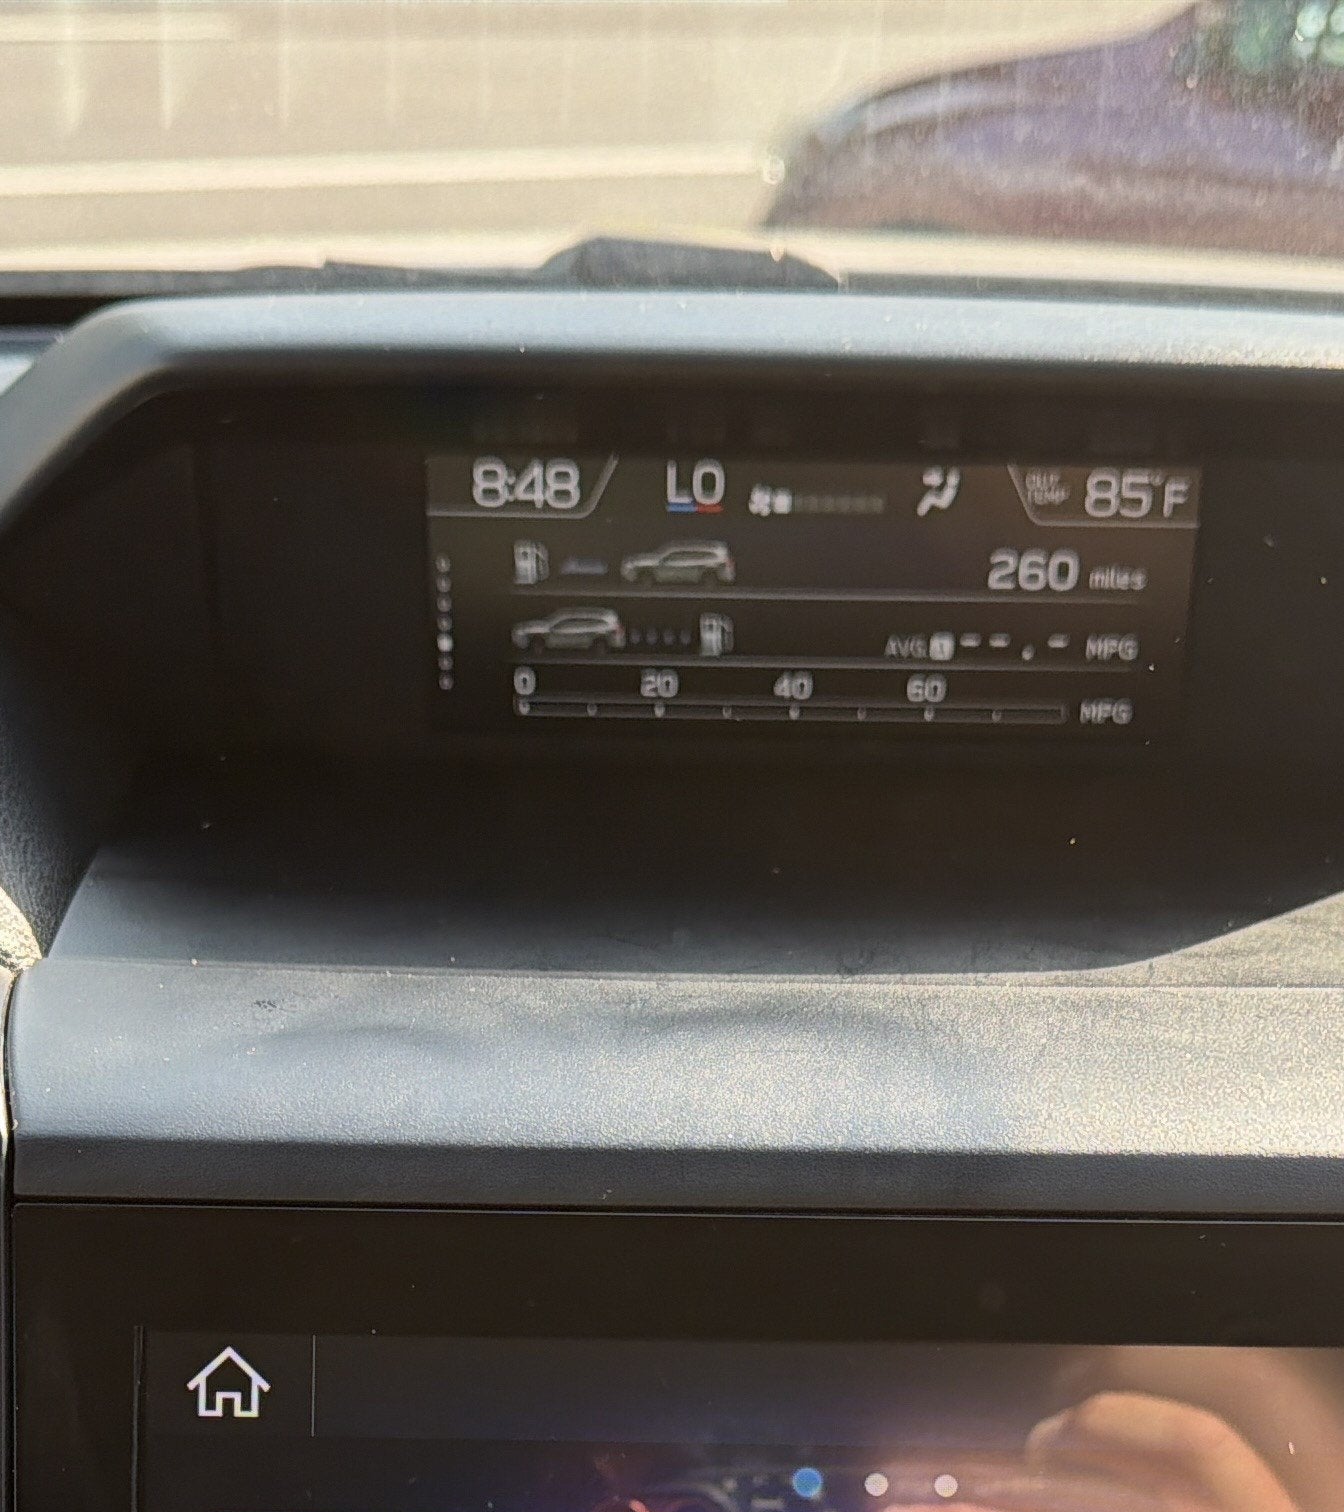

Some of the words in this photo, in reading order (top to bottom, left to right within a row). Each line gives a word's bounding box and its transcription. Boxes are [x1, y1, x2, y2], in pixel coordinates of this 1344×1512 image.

[472, 456, 581, 509] 8:48
[666, 459, 725, 504] LO
[987, 549, 1080, 591] 260
[1089, 567, 1148, 590] miles
[640, 668, 679, 698] 20
[773, 670, 813, 700] 40
[907, 673, 947, 703] 60
